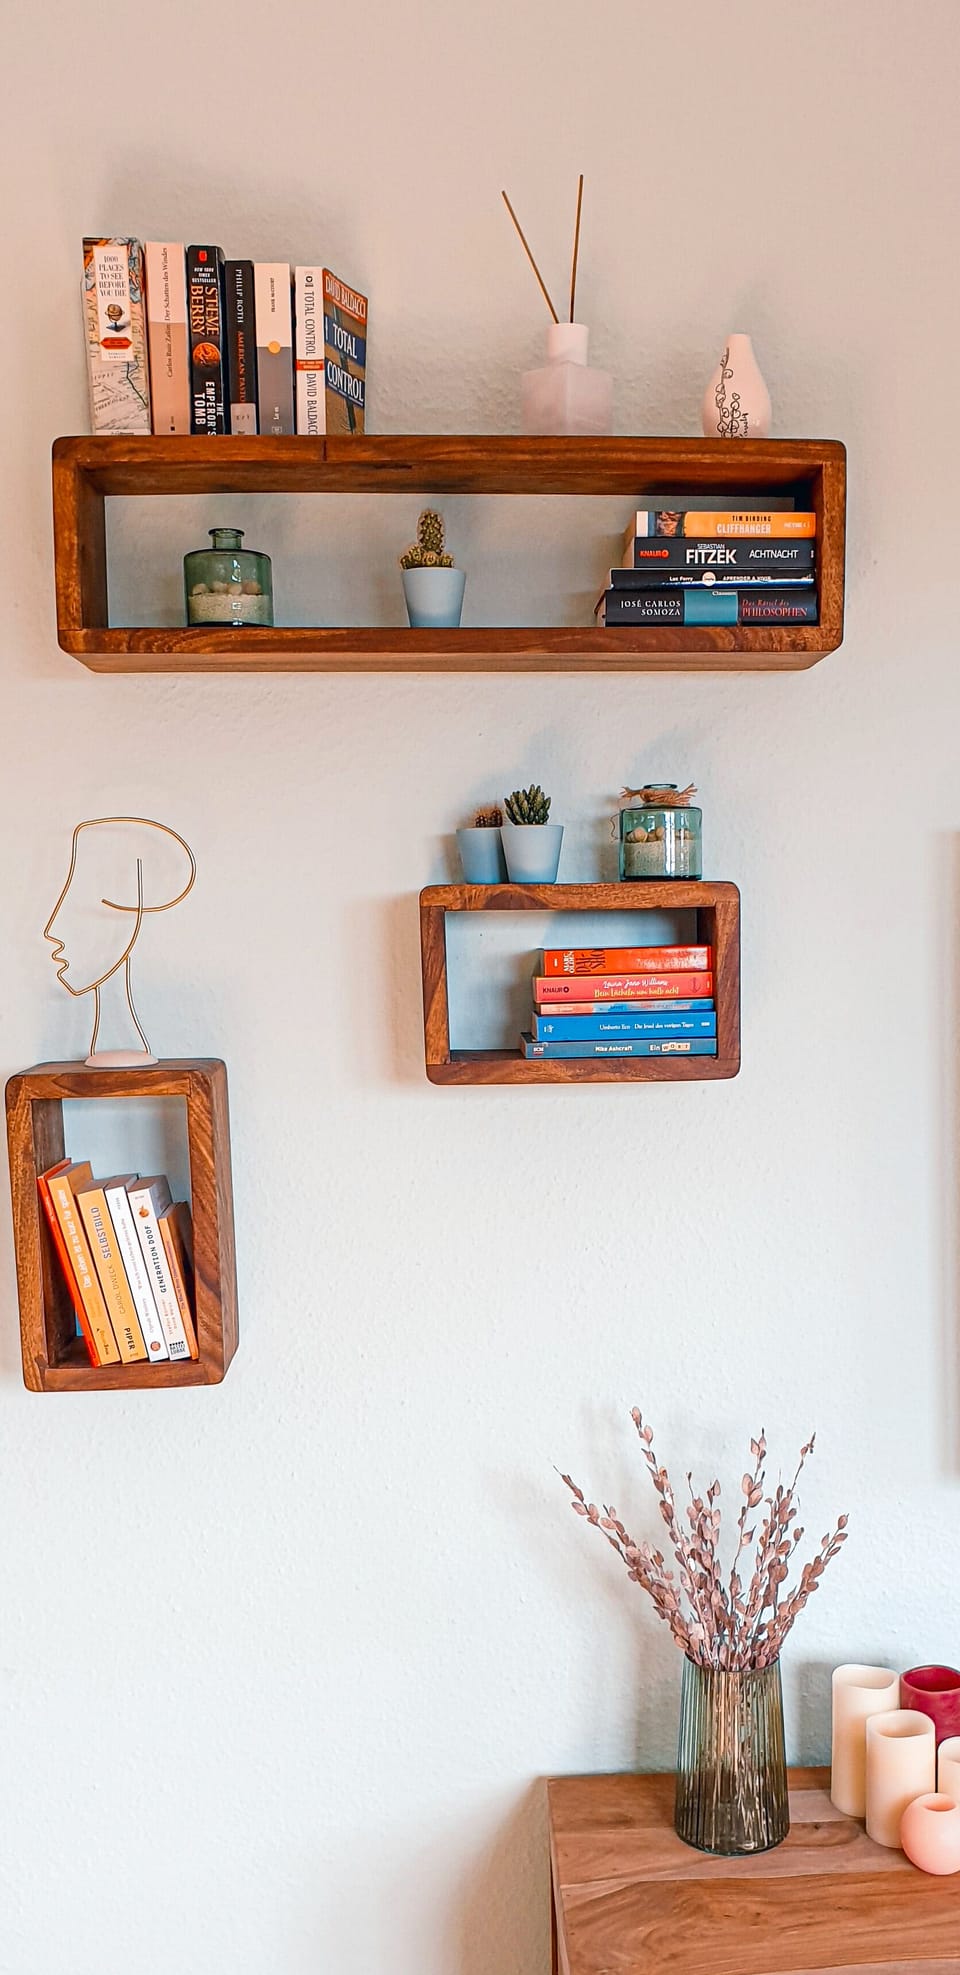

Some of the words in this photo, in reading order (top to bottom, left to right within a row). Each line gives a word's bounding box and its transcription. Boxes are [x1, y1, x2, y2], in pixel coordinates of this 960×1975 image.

[100, 272, 109, 280] TO
[110, 272, 122, 280] SEE
[235, 269, 243, 296] PHILIP
[304, 292, 315, 316] TOTAL
[326, 276, 340, 296] DAVID
[341, 284, 366, 319] BALDACCI
[191, 286, 205, 335] BERRY
[205, 286, 219, 335] STEVE
[236, 299, 244, 323] ROTH
[305, 319, 316, 356] CONTROL
[333, 324, 357, 358] TOTAL
[237, 331, 246, 374] AMERICAN
[306, 374, 317, 396] DAVID
[328, 361, 364, 402] CONTROL
[194, 393, 206, 425] TOMB
[206, 382, 216, 435] EMPEROR'S
[216, 402, 224, 416] THE
[717, 524, 771, 534] CLIFFHANGER
[686, 549, 736, 564] FITZEK
[749, 550, 798, 559] ACHTNACHT
[621, 599, 641, 608] JOSÉ
[742, 608, 808, 616] PHILOSOPHEN
[594, 989, 609, 997] Dein
[90, 1207, 112, 1259] SELBSTBILD
[144, 1225, 154, 1245] DOOF
[149, 1247, 167, 1293] GENERATION
[114, 1292, 126, 1315] CAROL
[123, 1327, 136, 1350] PIPER
